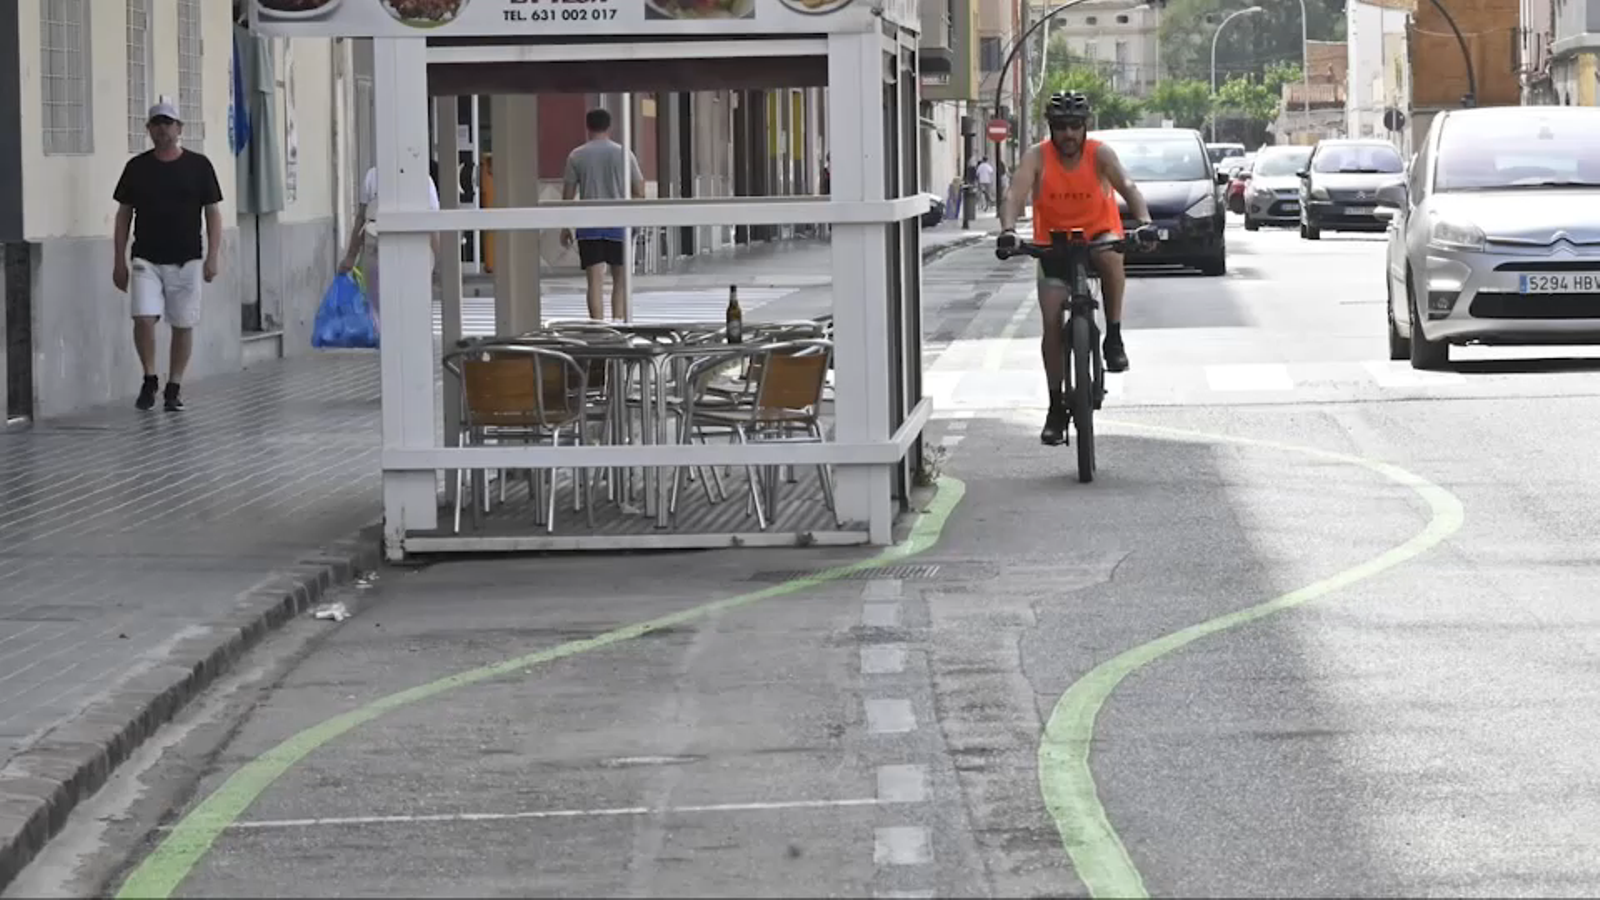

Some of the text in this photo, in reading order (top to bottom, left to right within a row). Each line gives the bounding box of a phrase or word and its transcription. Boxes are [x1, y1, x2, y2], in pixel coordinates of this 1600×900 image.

[503, 9, 617, 20] TEL. 631 002 017
[1529, 275, 1568, 291] 5294
